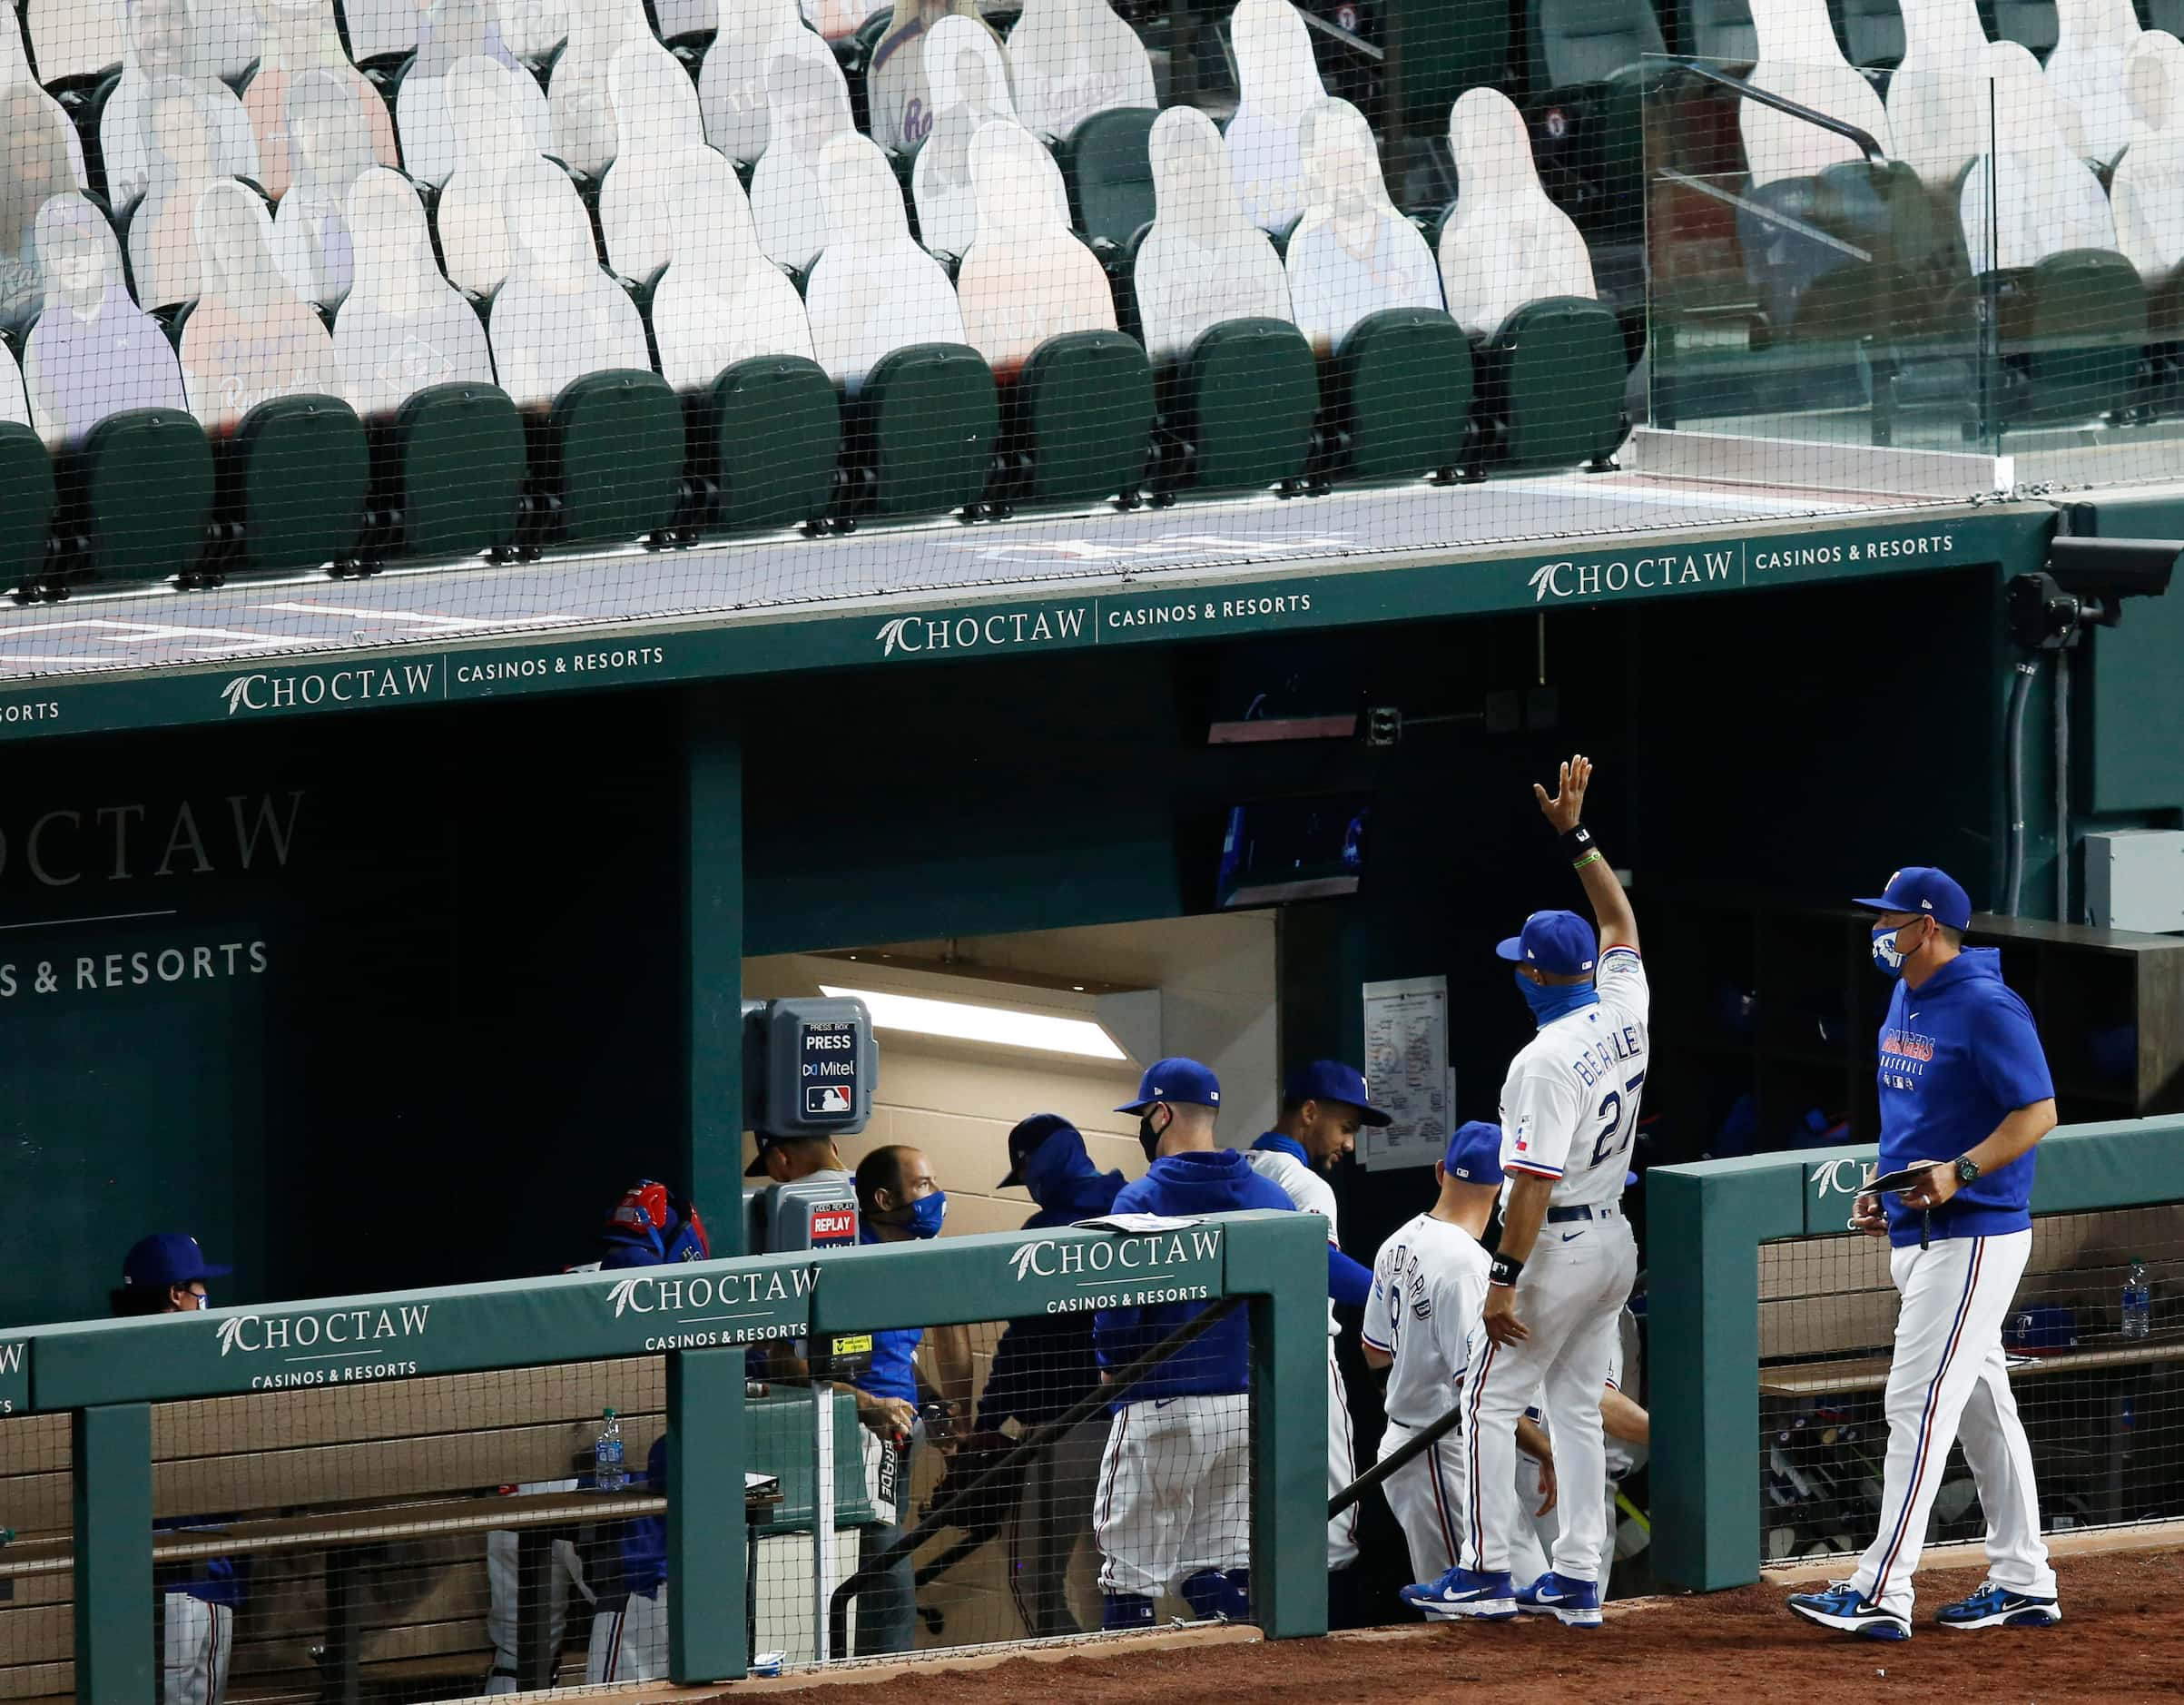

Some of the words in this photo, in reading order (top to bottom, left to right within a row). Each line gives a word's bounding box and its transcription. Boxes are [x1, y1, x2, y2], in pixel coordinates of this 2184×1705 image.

[1549, 551, 1732, 596] CHOCTAW
[1756, 547, 1841, 569] CASINOS
[1848, 545, 1861, 560] &
[1867, 536, 1953, 558] RESORTS
[897, 608, 1086, 652] CHOCTAW
[1108, 605, 1196, 627] CASINOS
[1205, 603, 1216, 619] &
[1224, 594, 1310, 617] RESORTS
[241, 664, 433, 711] CHOCTAW
[457, 659, 546, 683] CASINOS
[555, 657, 566, 673] &
[574, 647, 663, 671] RESORTS
[0, 702, 59, 723] ORTS
[0, 790, 305, 887] CTAW
[34, 961, 58, 994] &
[77, 941, 267, 990] RESORTS
[805, 1035, 851, 1050] PRESS
[820, 1059, 855, 1076] Mitel
[1589, 1069, 1646, 1170] 27
[814, 1216, 851, 1233] REPLAY
[1030, 1230, 1221, 1276] CHOCTAW
[628, 1267, 822, 1313] CHOCTAW
[1047, 1294, 1117, 1314] CASINOS
[1122, 1293, 1133, 1307] &
[1137, 1286, 1207, 1305] RESORTS
[234, 1305, 430, 1352] CHOCTAW
[645, 1331, 716, 1351] CASINOS
[722, 1330, 732, 1345] &
[736, 1323, 807, 1342] RESORTS
[1390, 1285, 1402, 1360] 8
[251, 1370, 324, 1389] CASINOS
[329, 1368, 339, 1382] &
[343, 1361, 417, 1381] RESORTS
